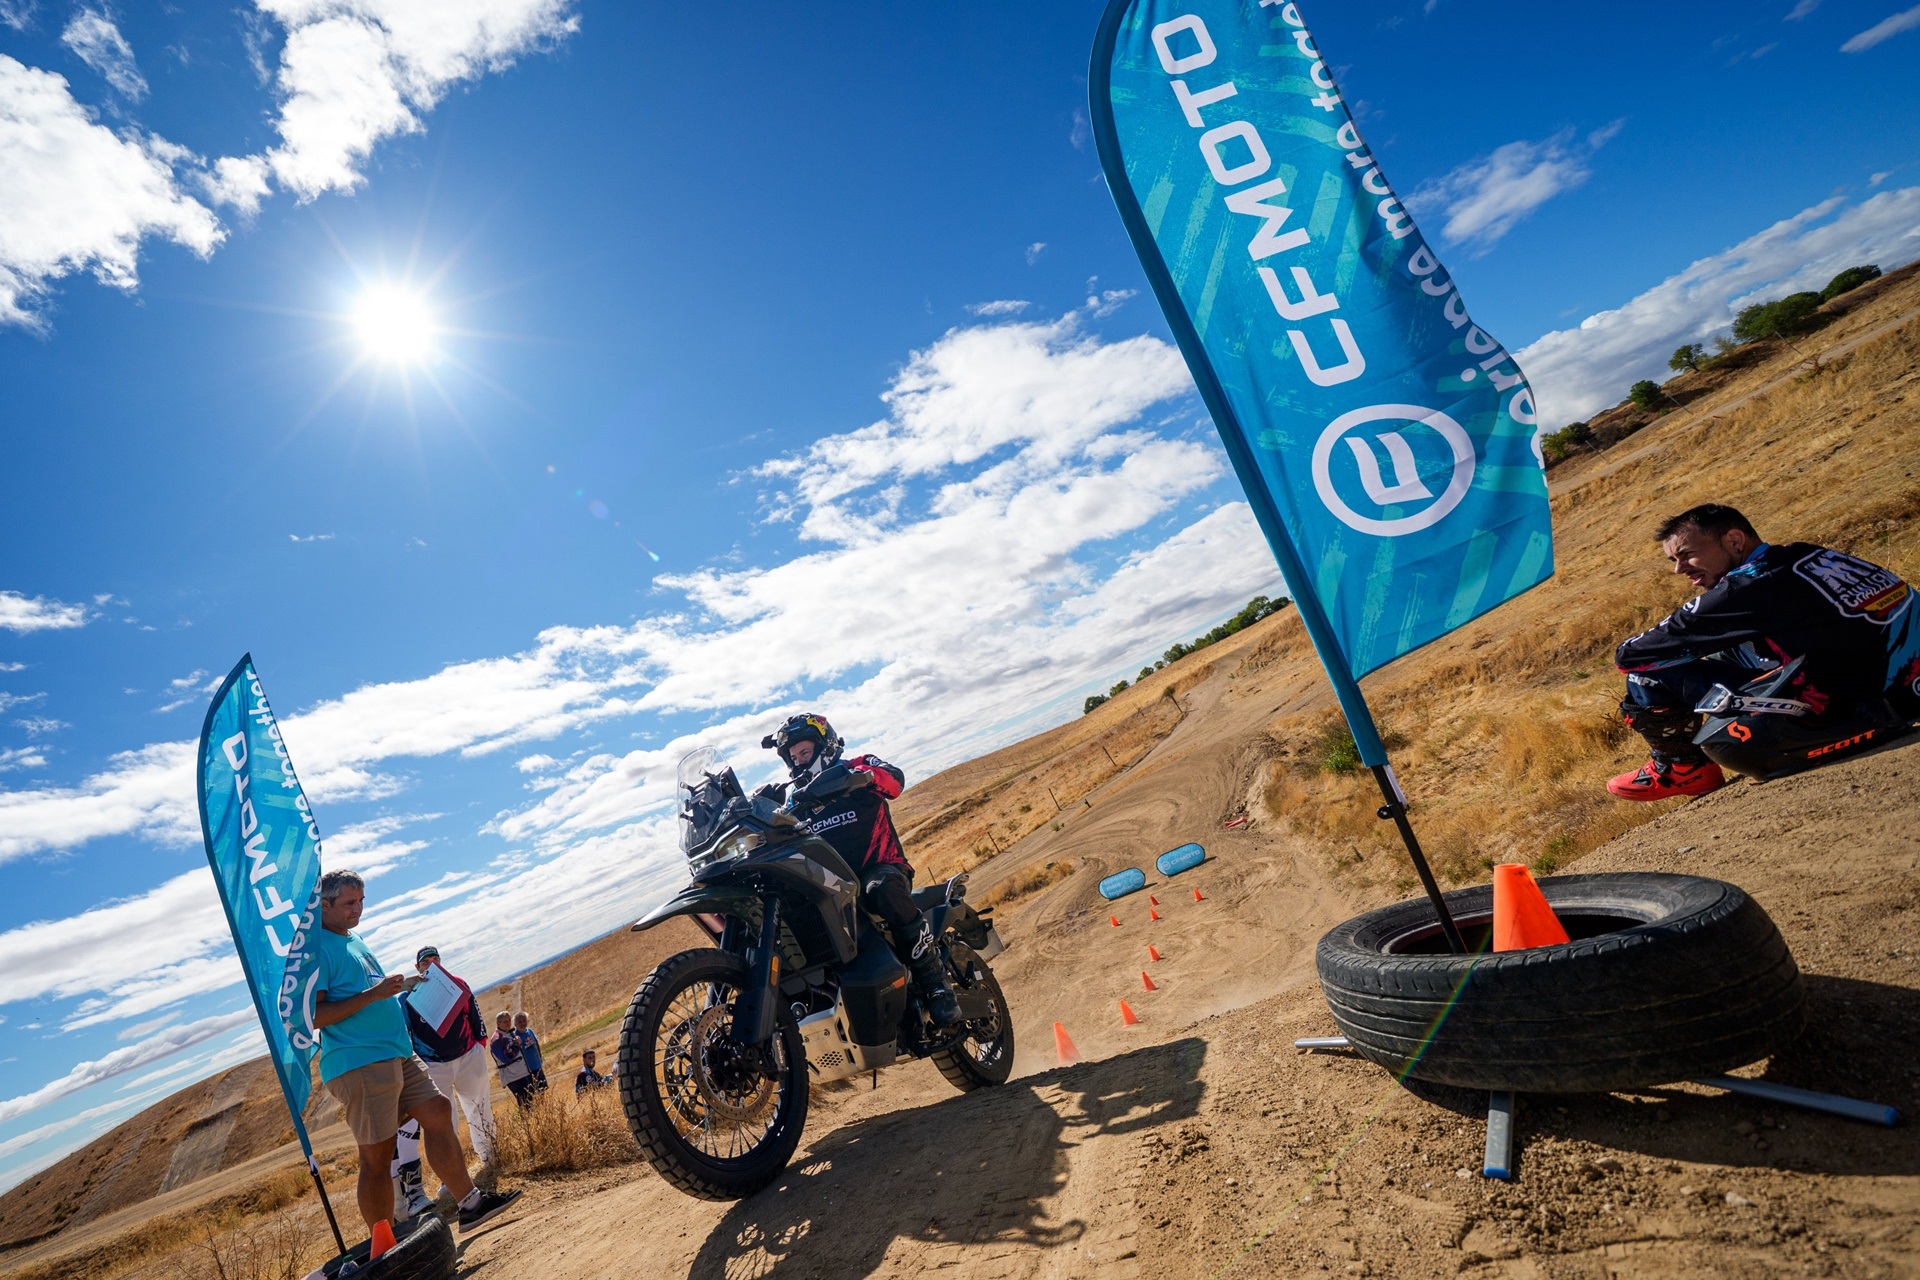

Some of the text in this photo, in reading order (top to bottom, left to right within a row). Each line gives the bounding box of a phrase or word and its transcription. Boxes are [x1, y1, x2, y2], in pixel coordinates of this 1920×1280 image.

[1150, 13, 1366, 387] CFMOTO
[1336, 118, 1417, 240] more
[246, 668, 297, 789] together
[1807, 729, 1876, 759] SCOTT
[221, 730, 300, 957] CFMOTO
[812, 810, 856, 831] CFMOTO
[1171, 849, 1200, 865] CFMOTO
